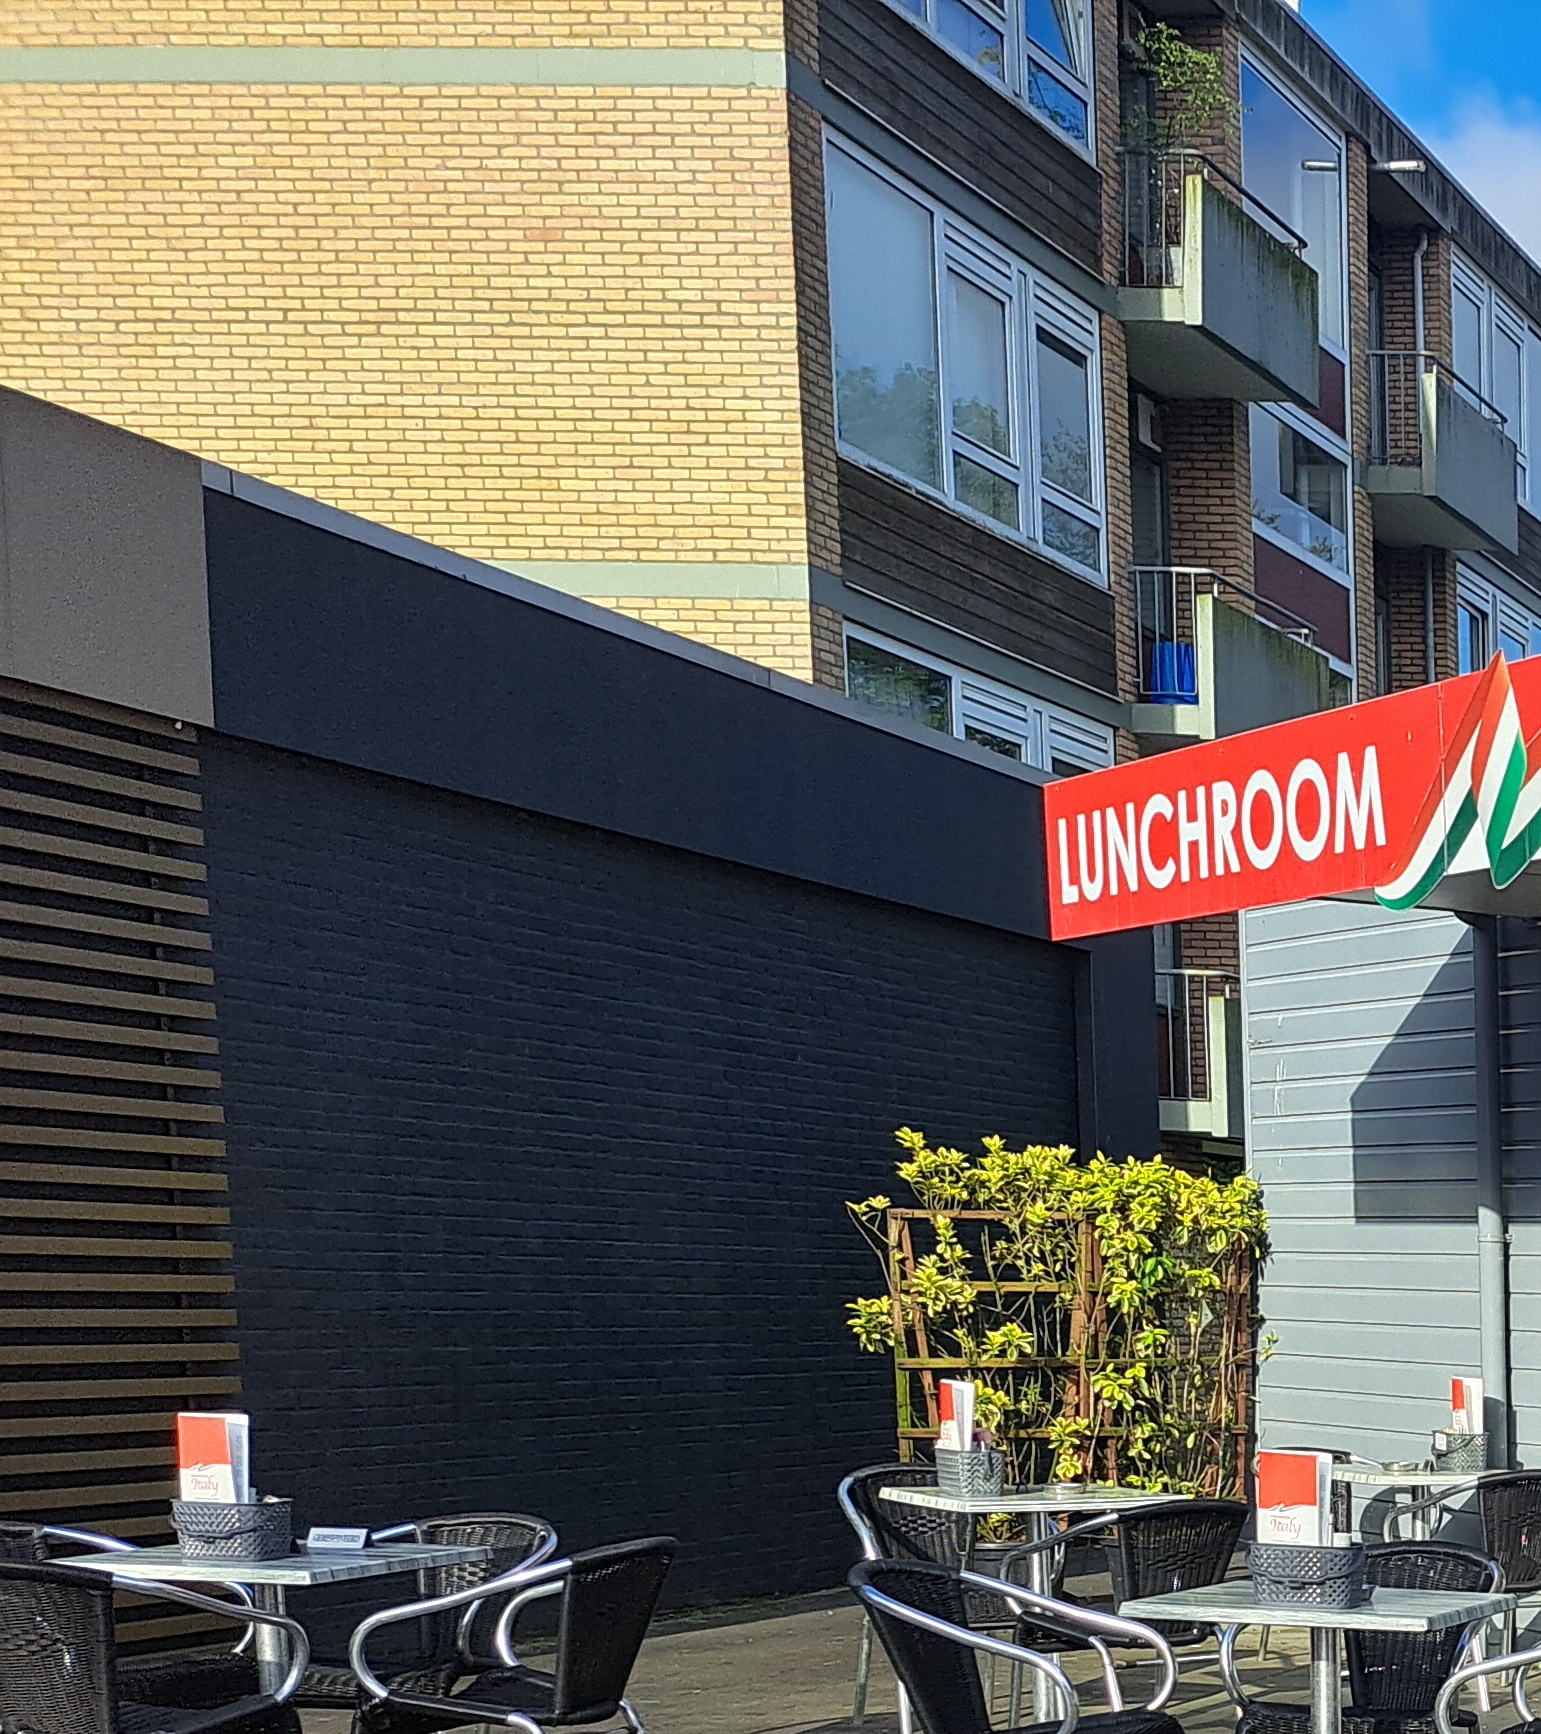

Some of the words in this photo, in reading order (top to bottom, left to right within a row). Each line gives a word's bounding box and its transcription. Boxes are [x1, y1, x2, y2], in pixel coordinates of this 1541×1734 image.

[1057, 745, 1387, 905] LUNCHROOM
[191, 1474, 220, 1497] Italy
[1269, 1516, 1302, 1541] Italy
